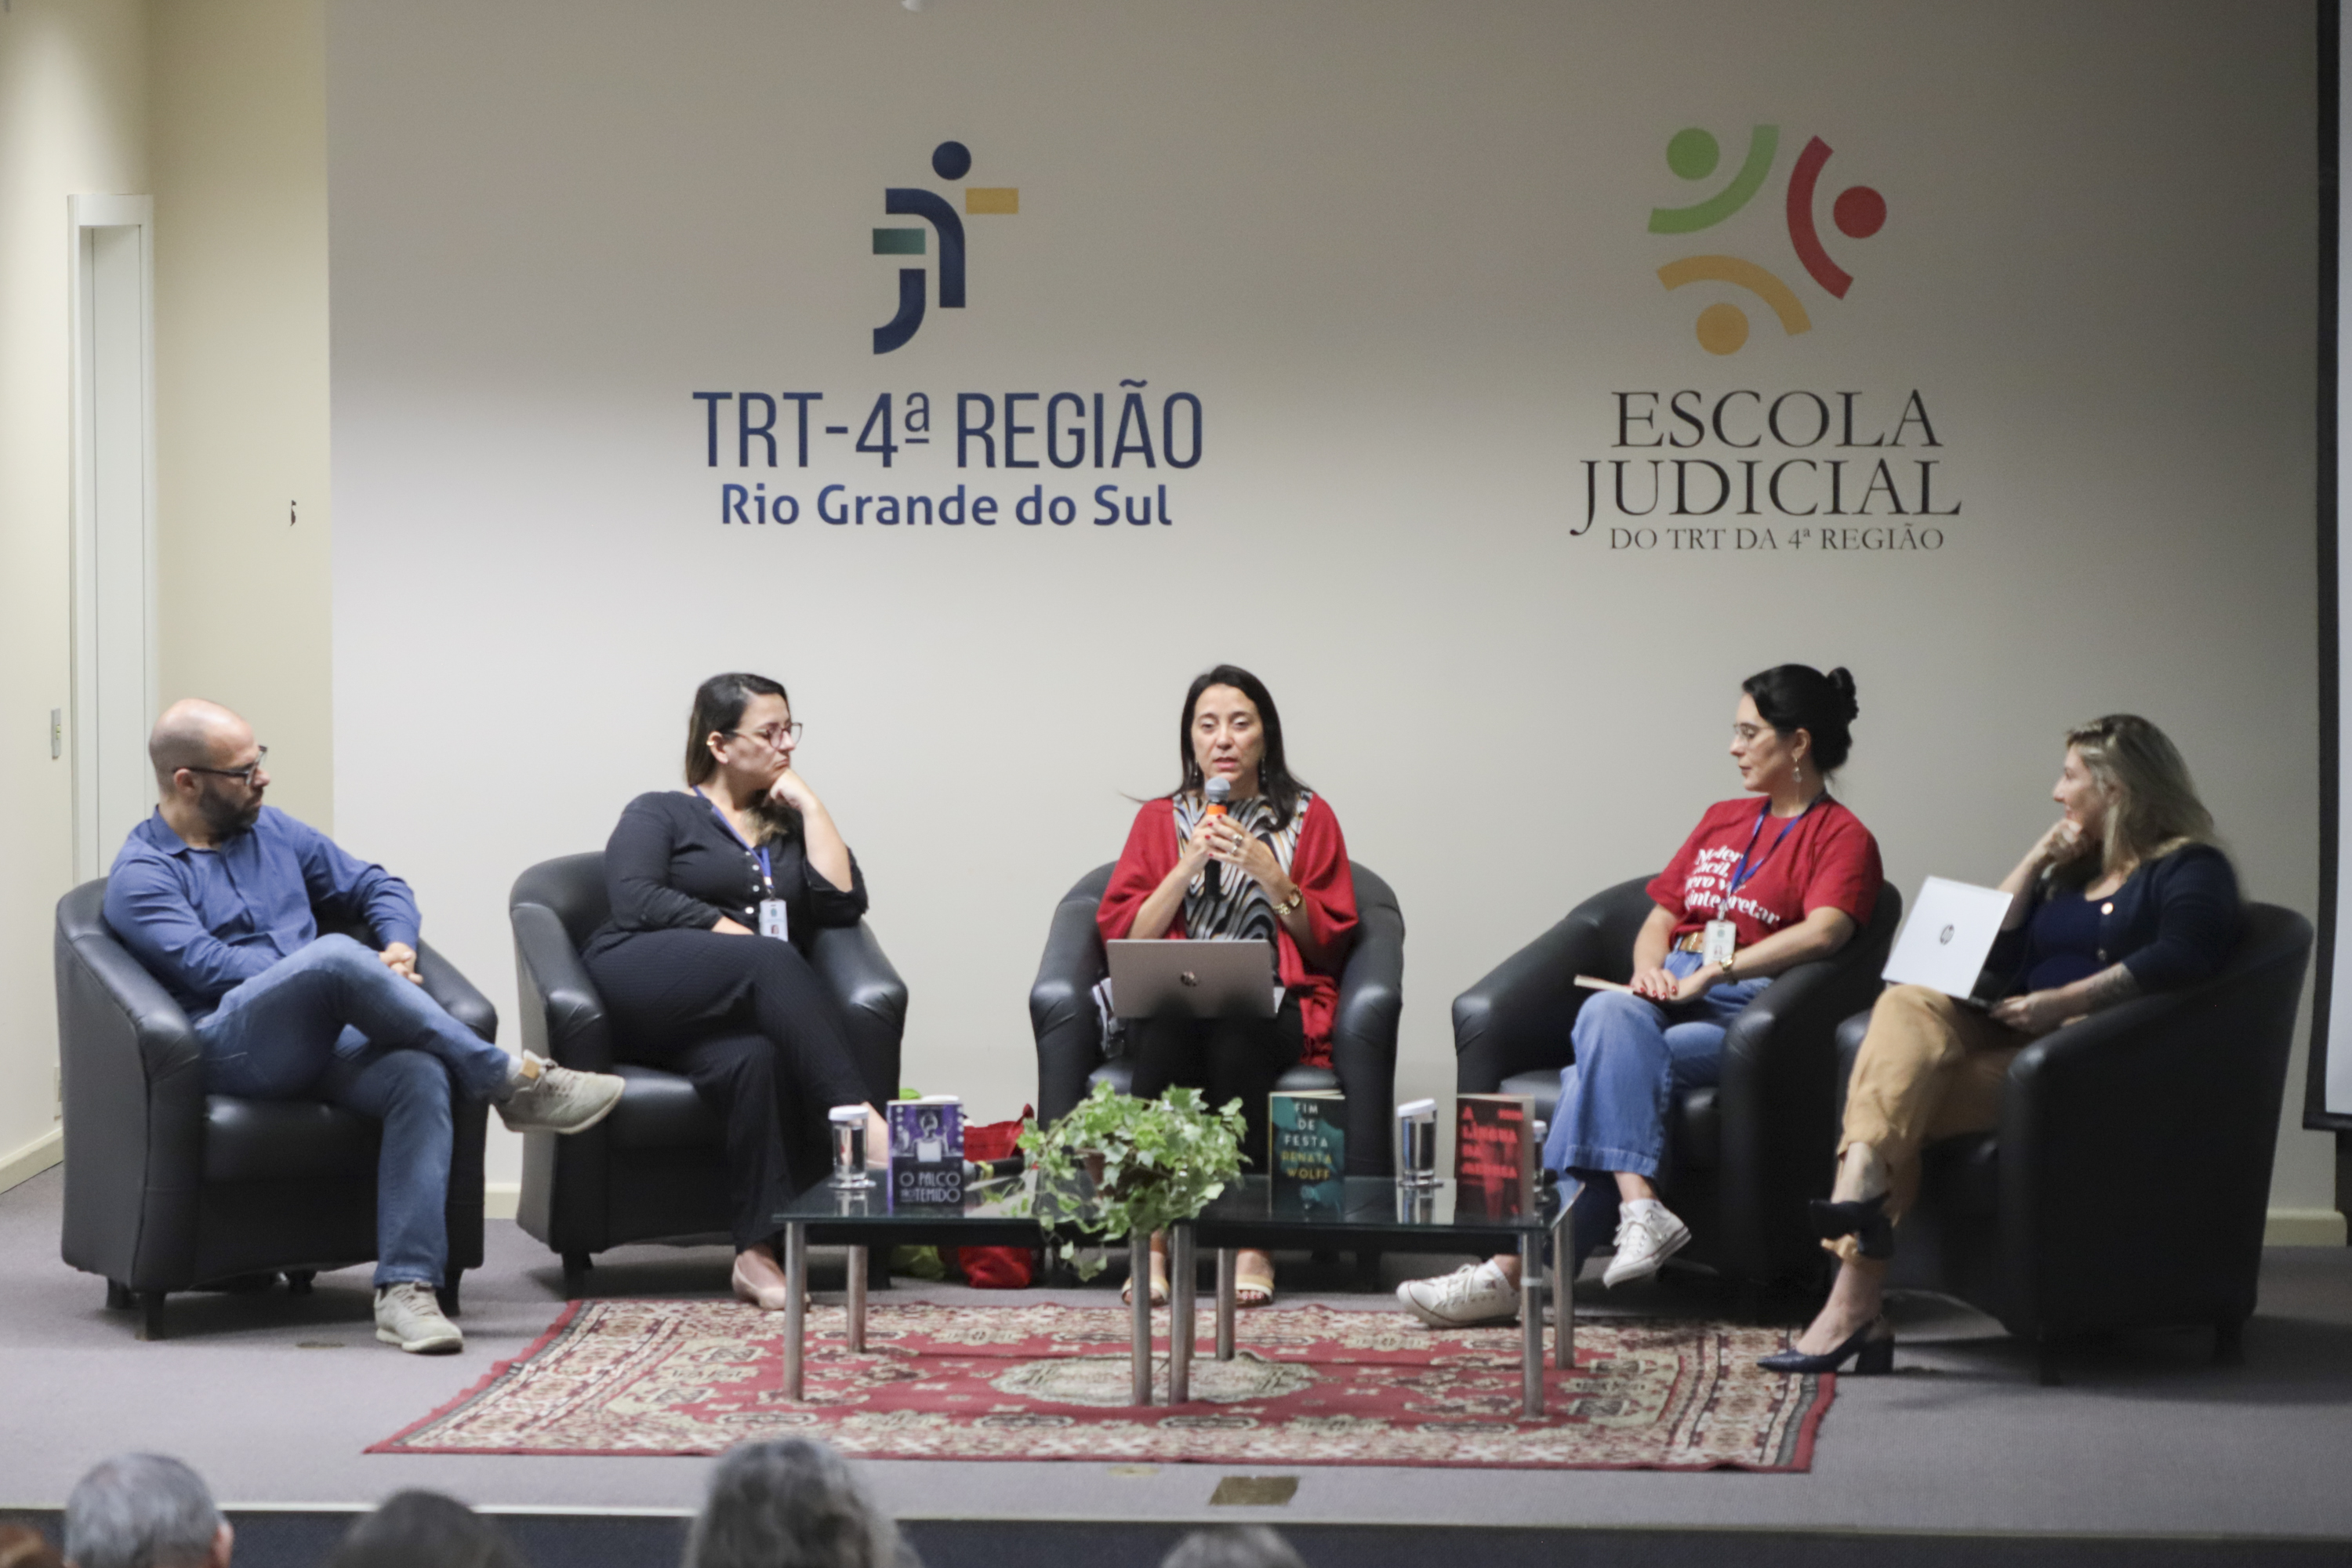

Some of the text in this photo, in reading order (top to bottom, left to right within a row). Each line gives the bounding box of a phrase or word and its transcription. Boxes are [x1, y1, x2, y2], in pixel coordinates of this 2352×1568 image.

[956, 379, 1203, 469] REGIÃO
[1611, 389, 1944, 448] ESCOLA
[722, 483, 1173, 526] Rio Grande do Sul
[1570, 458, 1962, 536] JUDICIAL
[1610, 522, 1944, 550] DO TRT DA 4ª REGIÃO
[1294, 1102, 1319, 1115] FIM
[1298, 1118, 1316, 1131] DE
[1284, 1134, 1328, 1148] FESTA
[1281, 1151, 1332, 1164] RENATA
[899, 1171, 915, 1187] O
